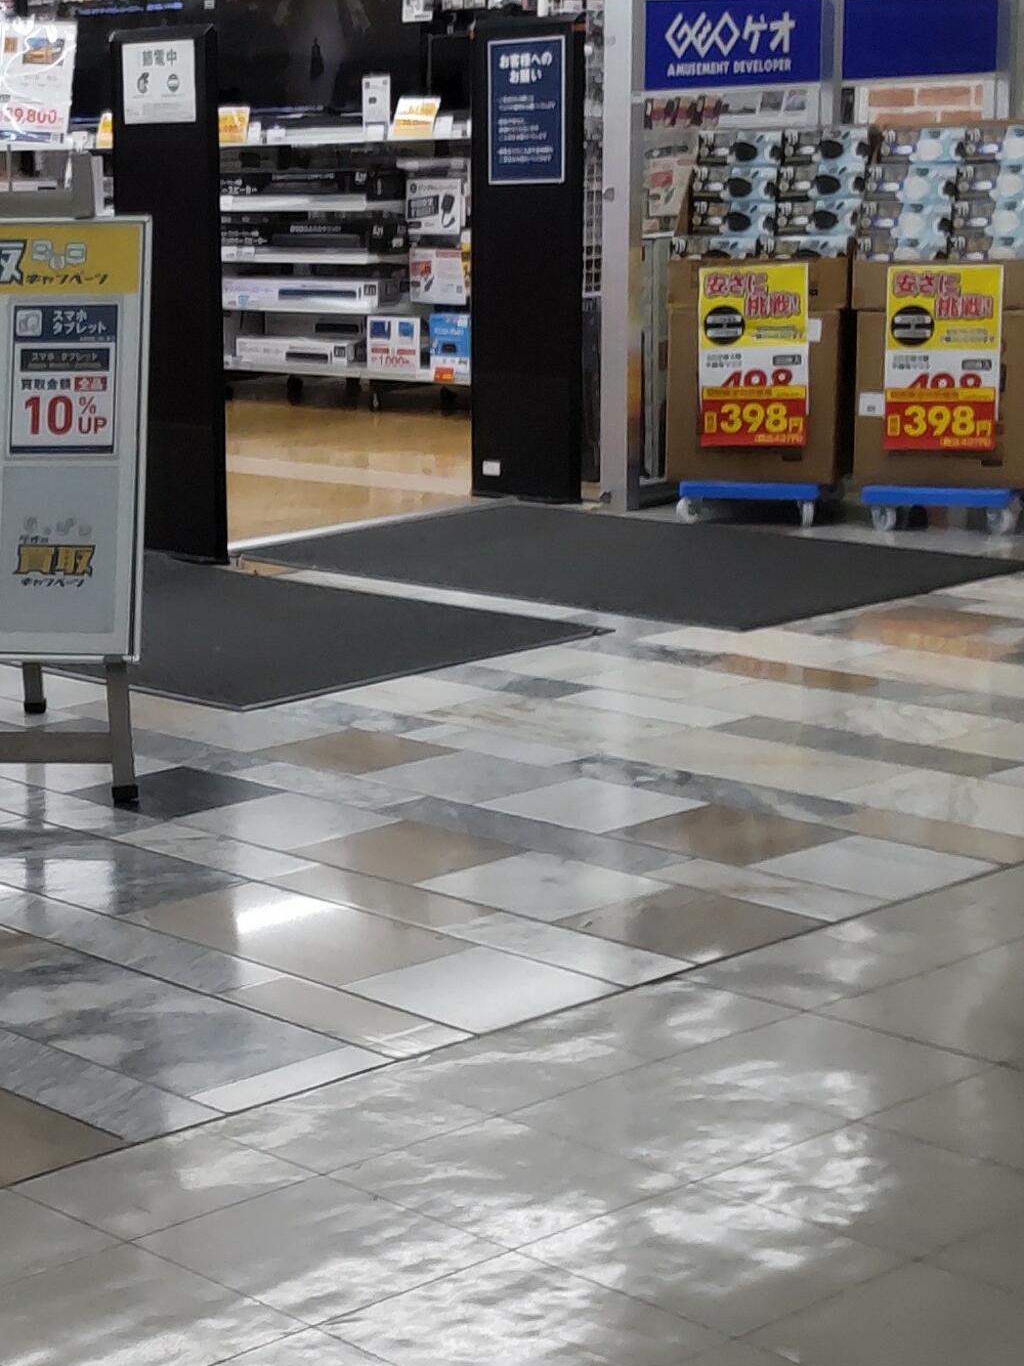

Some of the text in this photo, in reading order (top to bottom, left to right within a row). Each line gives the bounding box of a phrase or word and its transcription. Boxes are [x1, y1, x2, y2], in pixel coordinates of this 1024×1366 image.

[665, 11, 796, 59] GEO ゲオ
[667, 58, 791, 77] AMUSEMENT DEVELOPER
[705, 273, 768, 297] 安さに
[894, 272, 961, 297] 安さに
[53, 309, 87, 322] スマホ
[53, 322, 107, 335] タブレット
[21, 378, 71, 390] 買取金額
